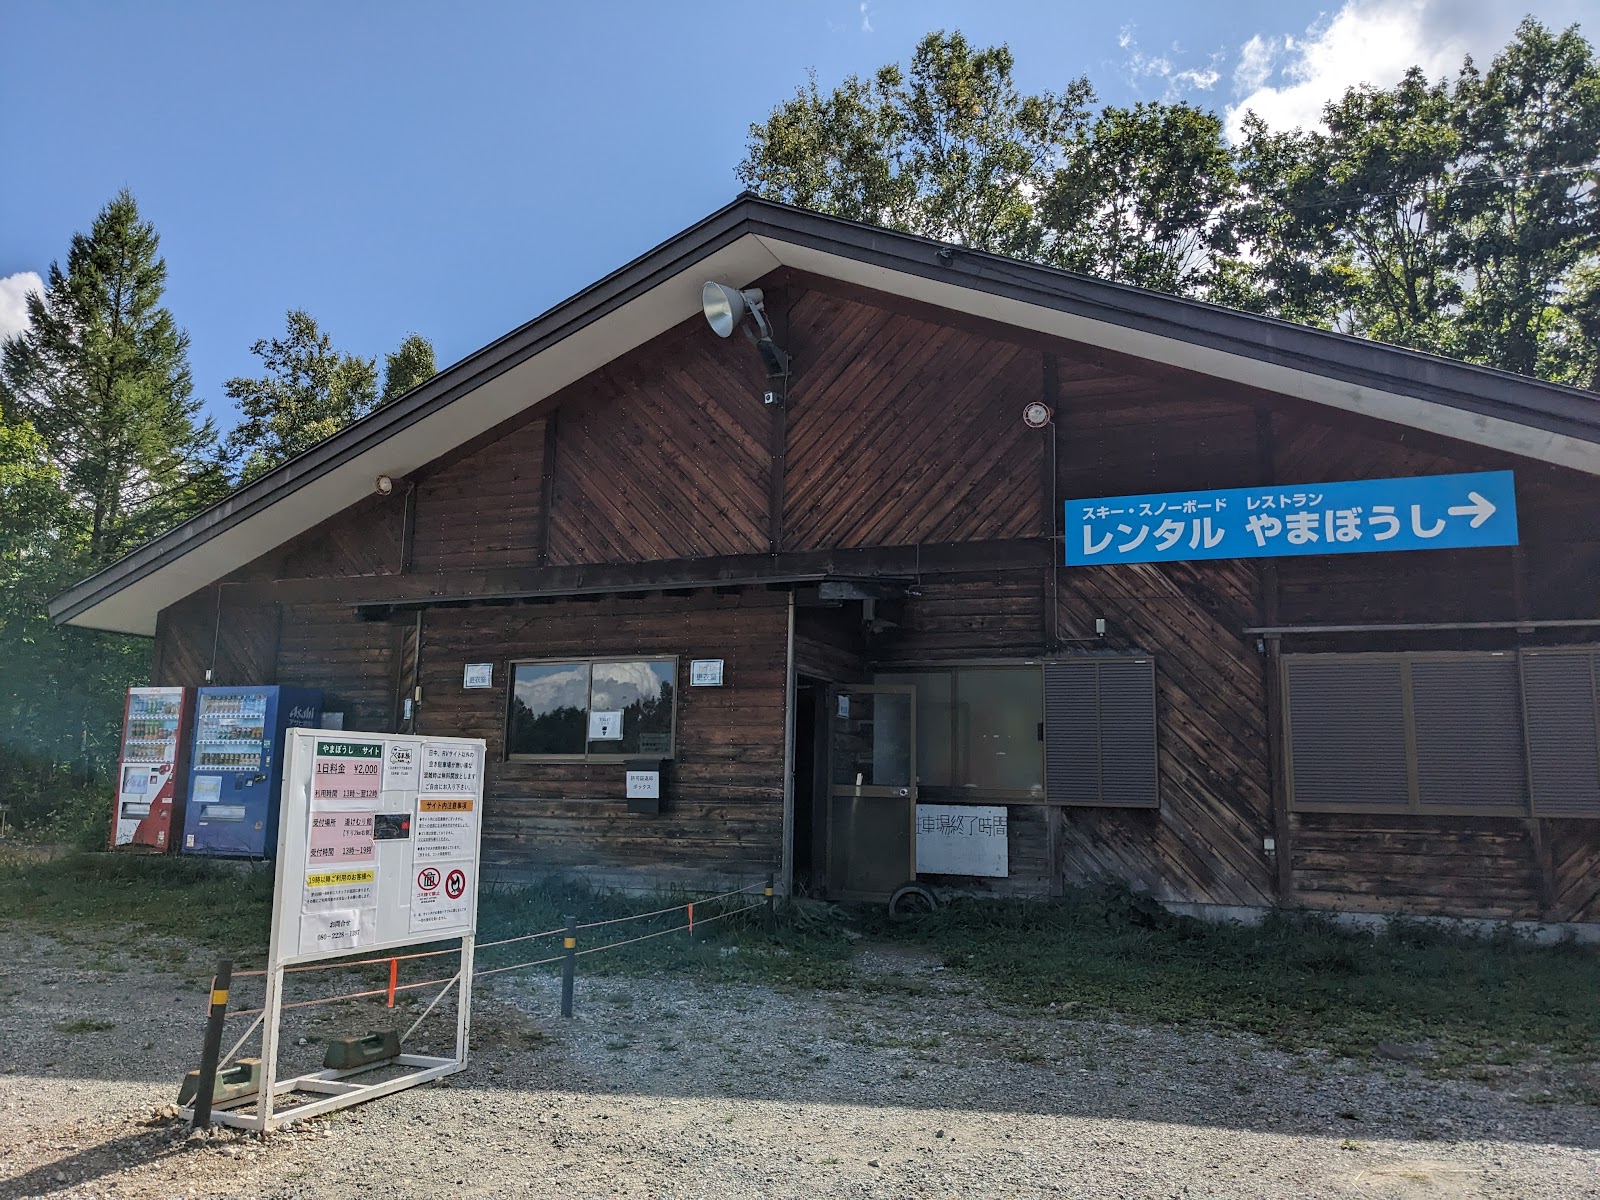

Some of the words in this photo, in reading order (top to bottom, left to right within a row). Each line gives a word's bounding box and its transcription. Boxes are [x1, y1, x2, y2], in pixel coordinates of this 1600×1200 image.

[1082, 497, 1227, 521] スキー・スノーボード
[1246, 493, 1323, 510] レストラン
[1082, 517, 1226, 556] レンタル
[1245, 504, 1447, 548] やまぼうし
[322, 745, 354, 755] やまぼうし
[362, 747, 380, 755] サイト
[317, 763, 346, 774] 1日料金
[354, 764, 378, 775] ¥2,000
[314, 789, 338, 798] 利用時間
[426, 801, 468, 810] サイト内注意事項
[312, 818, 337, 827] 受付場所
[310, 847, 335, 857] 受付時間
